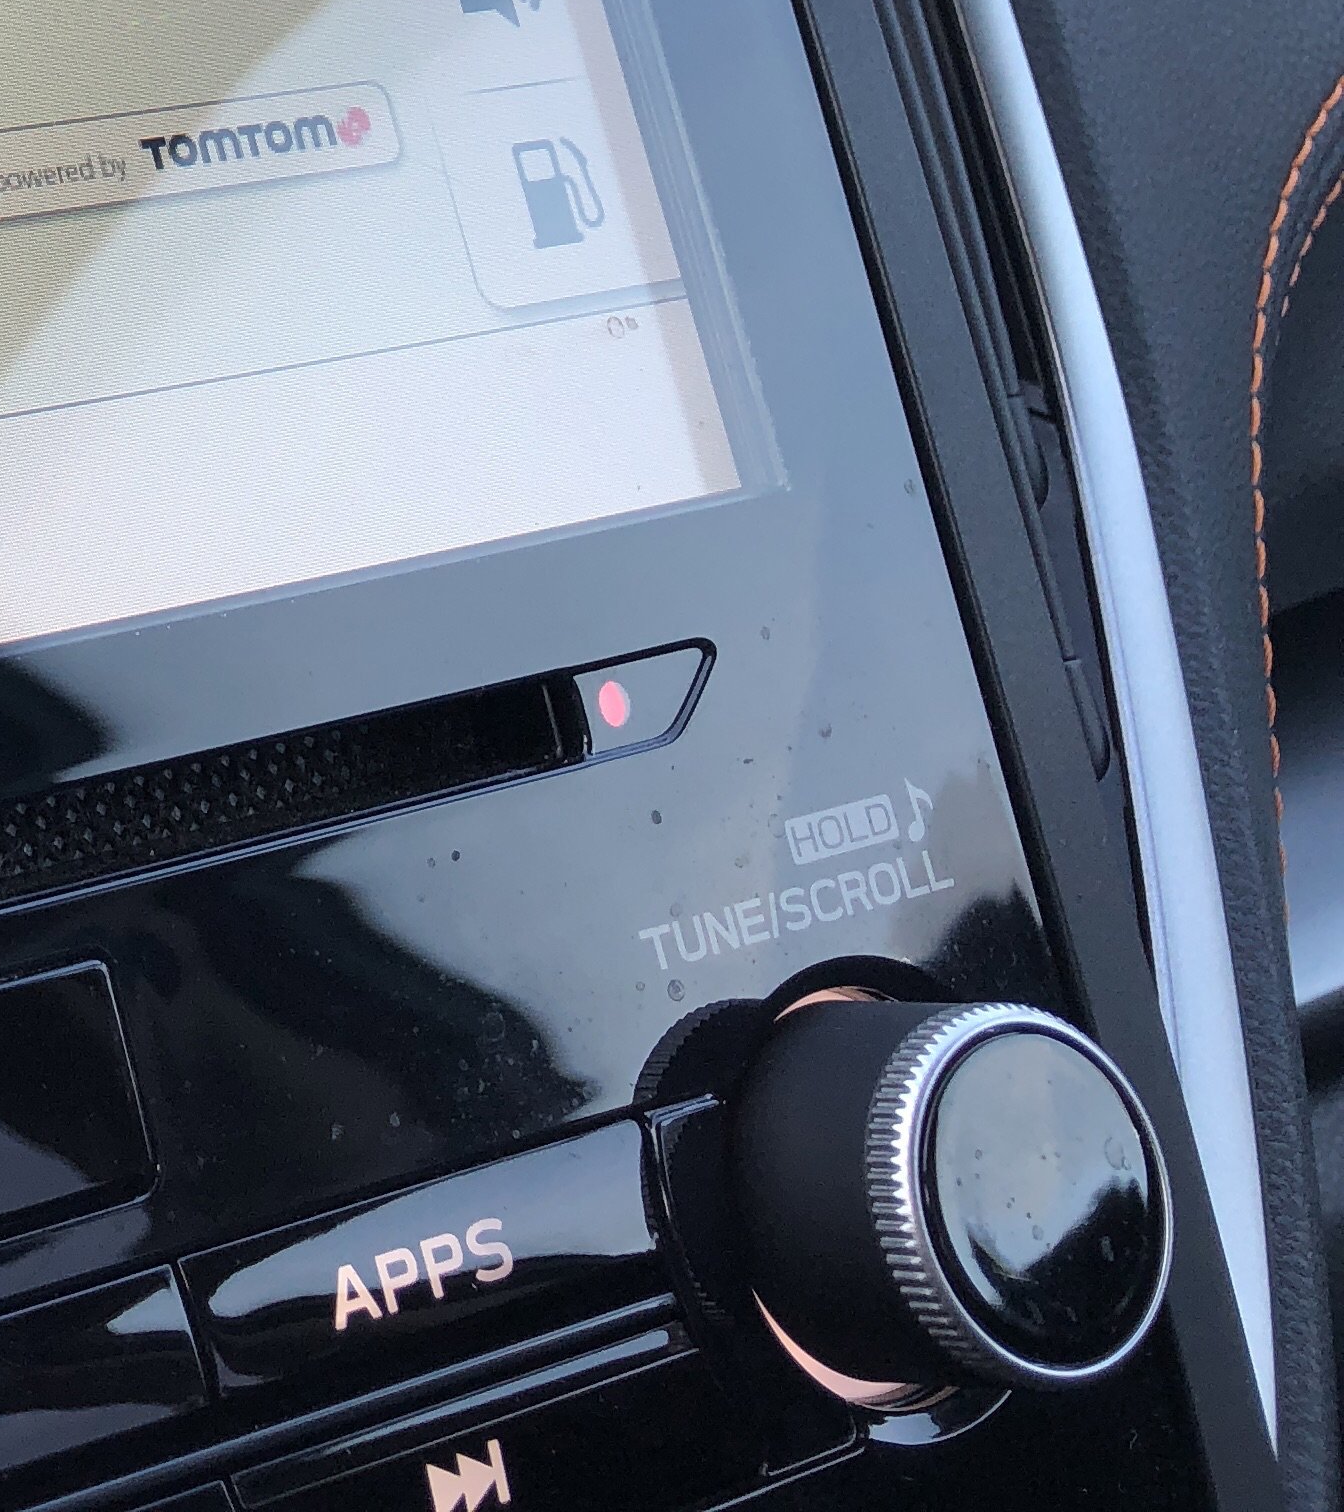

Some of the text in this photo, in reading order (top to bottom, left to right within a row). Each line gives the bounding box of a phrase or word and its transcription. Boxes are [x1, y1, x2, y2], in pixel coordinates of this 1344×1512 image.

[97, 151, 128, 182] by
[789, 801, 895, 859] HOLD
[638, 850, 955, 971] TUNE/SCROLL
[333, 1217, 515, 1333] APPS
